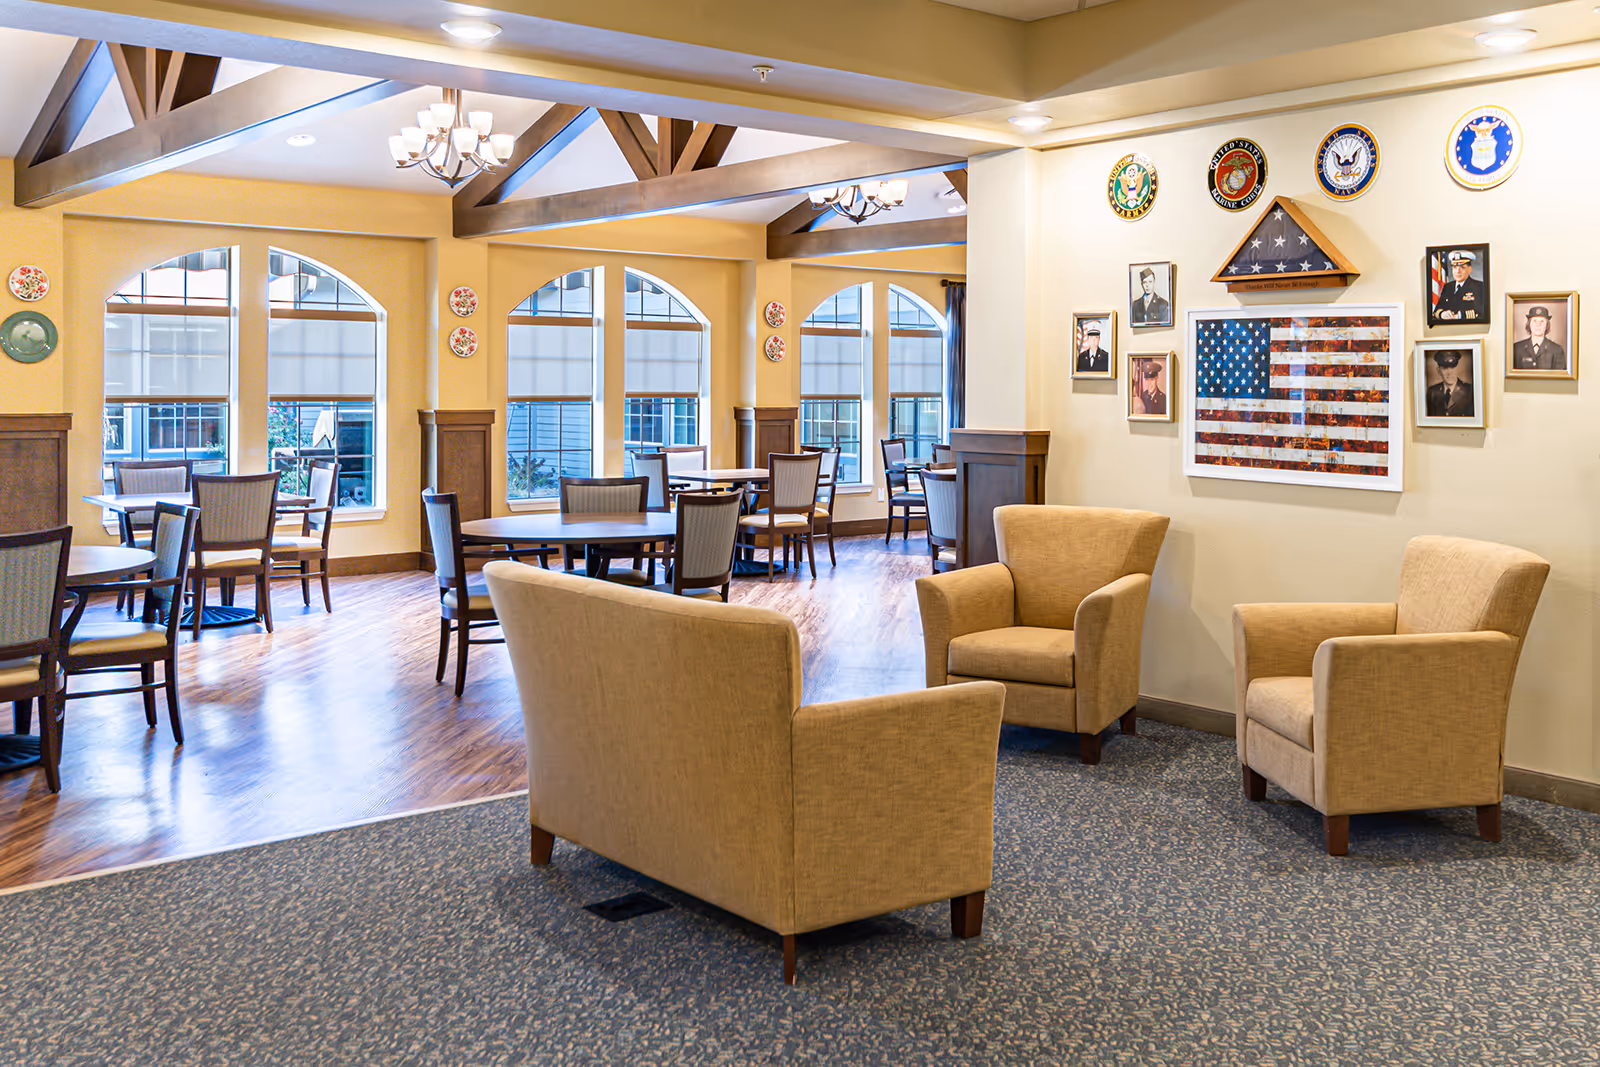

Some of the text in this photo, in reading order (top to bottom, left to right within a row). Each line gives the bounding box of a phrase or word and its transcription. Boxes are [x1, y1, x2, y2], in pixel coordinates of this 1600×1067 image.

[1210, 141, 1263, 170] UNITED STATES
[1318, 130, 1376, 173] UNITED STATES
[1211, 183, 1262, 208] MARINE CORPS
[1335, 186, 1358, 195] NAVY
[1120, 207, 1145, 217] ARMY
